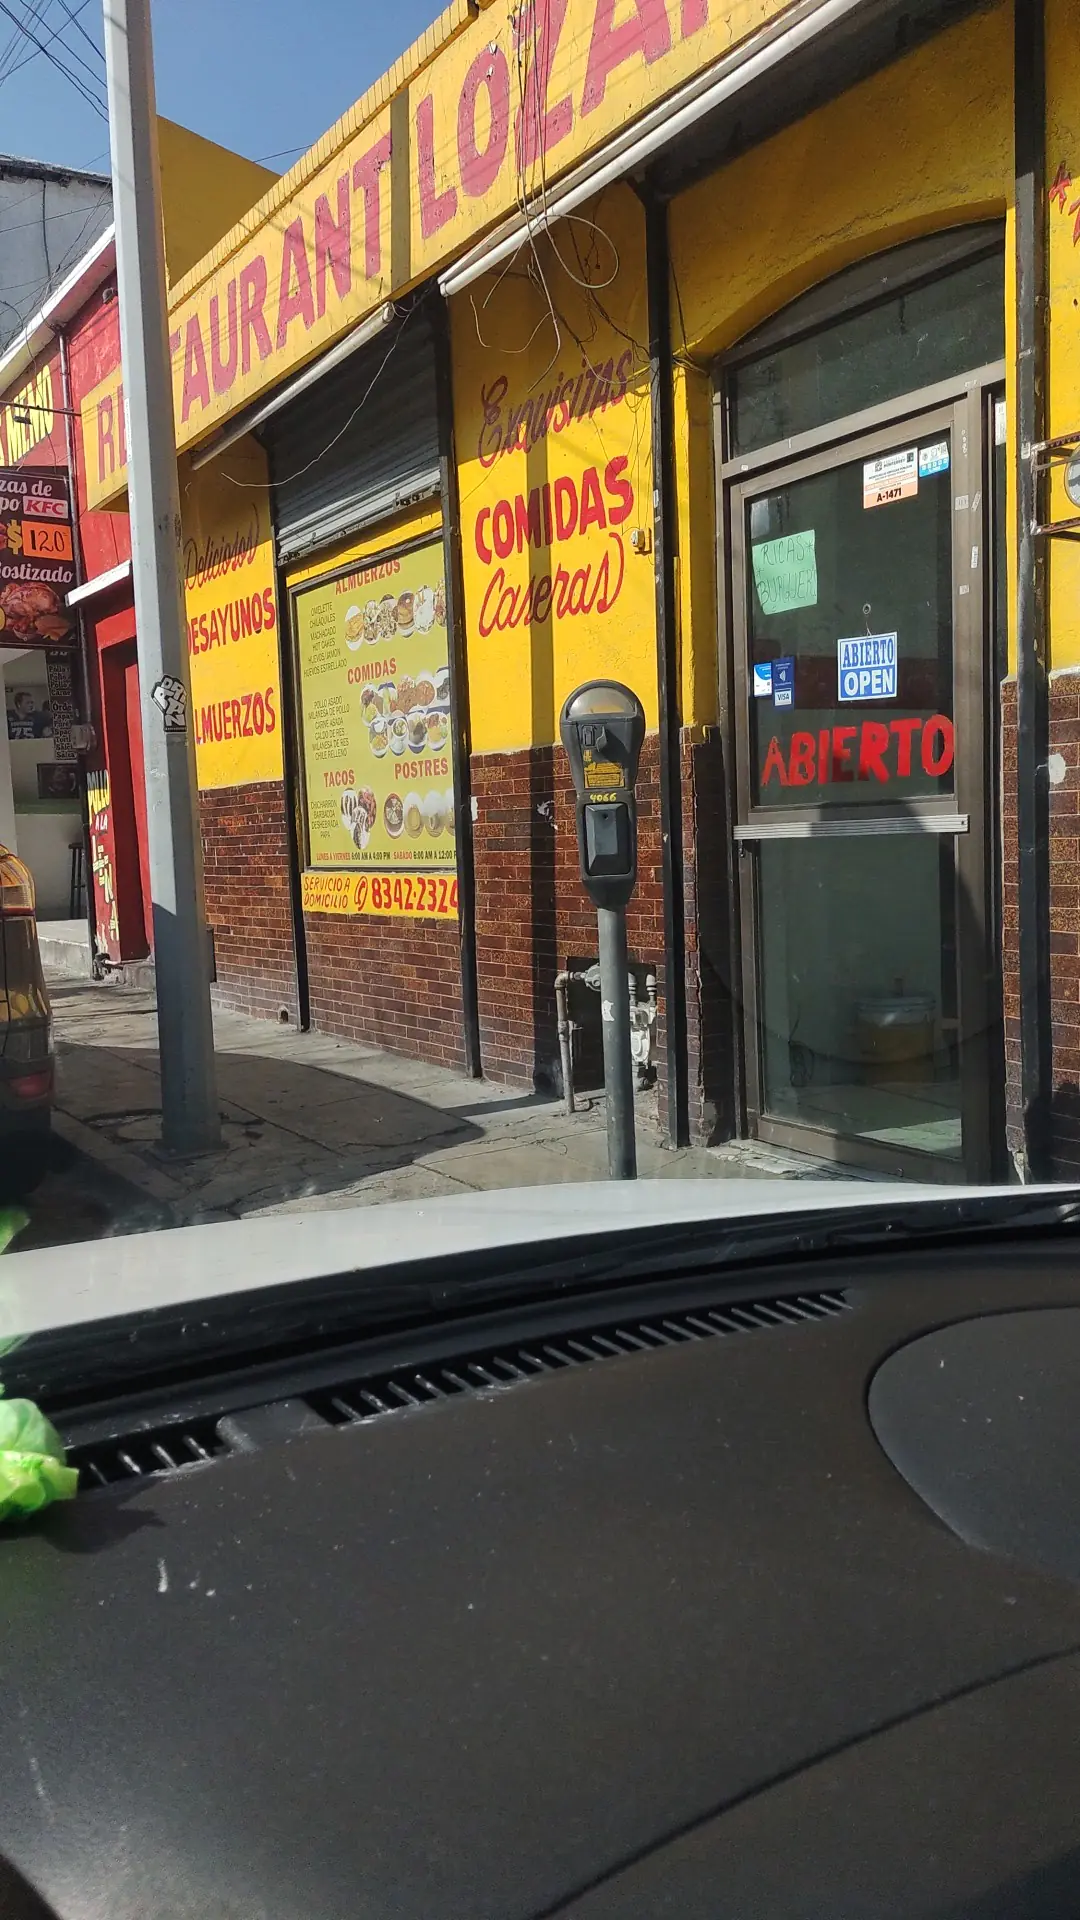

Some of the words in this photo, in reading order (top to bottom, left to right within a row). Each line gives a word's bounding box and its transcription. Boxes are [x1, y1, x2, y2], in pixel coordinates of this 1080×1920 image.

[31, 480, 52, 497] de
[876, 487, 902, 503] A-1471
[25, 499, 65, 516] KFC
[475, 455, 635, 565] COMIDAS
[0, 562, 73, 583] ostizado
[335, 559, 401, 596] ALMUERZOS
[479, 532, 624, 638] Caseras
[842, 637, 894, 668] ABIERTO
[347, 657, 397, 685] COMIDAS
[844, 668, 893, 696] OPEN
[777, 693, 790, 701] VISA
[194, 687, 276, 746] LMUERZOS
[760, 713, 955, 787] ABIERTO
[323, 769, 356, 788] TACOS
[394, 757, 449, 780] POSTRES
[316, 852, 329, 861] LUNES
[333, 852, 351, 861] VIERNES
[361, 852, 368, 861] AM
[373, 851, 383, 860] 4:00
[383, 851, 391, 860] PM
[425, 850, 433, 860] AM
[433, 850, 438, 860] A
[438, 850, 453, 860] 12:00
[303, 876, 343, 893] SERVICIO
[344, 877, 350, 892] A
[303, 892, 349, 909] DOMICILIO
